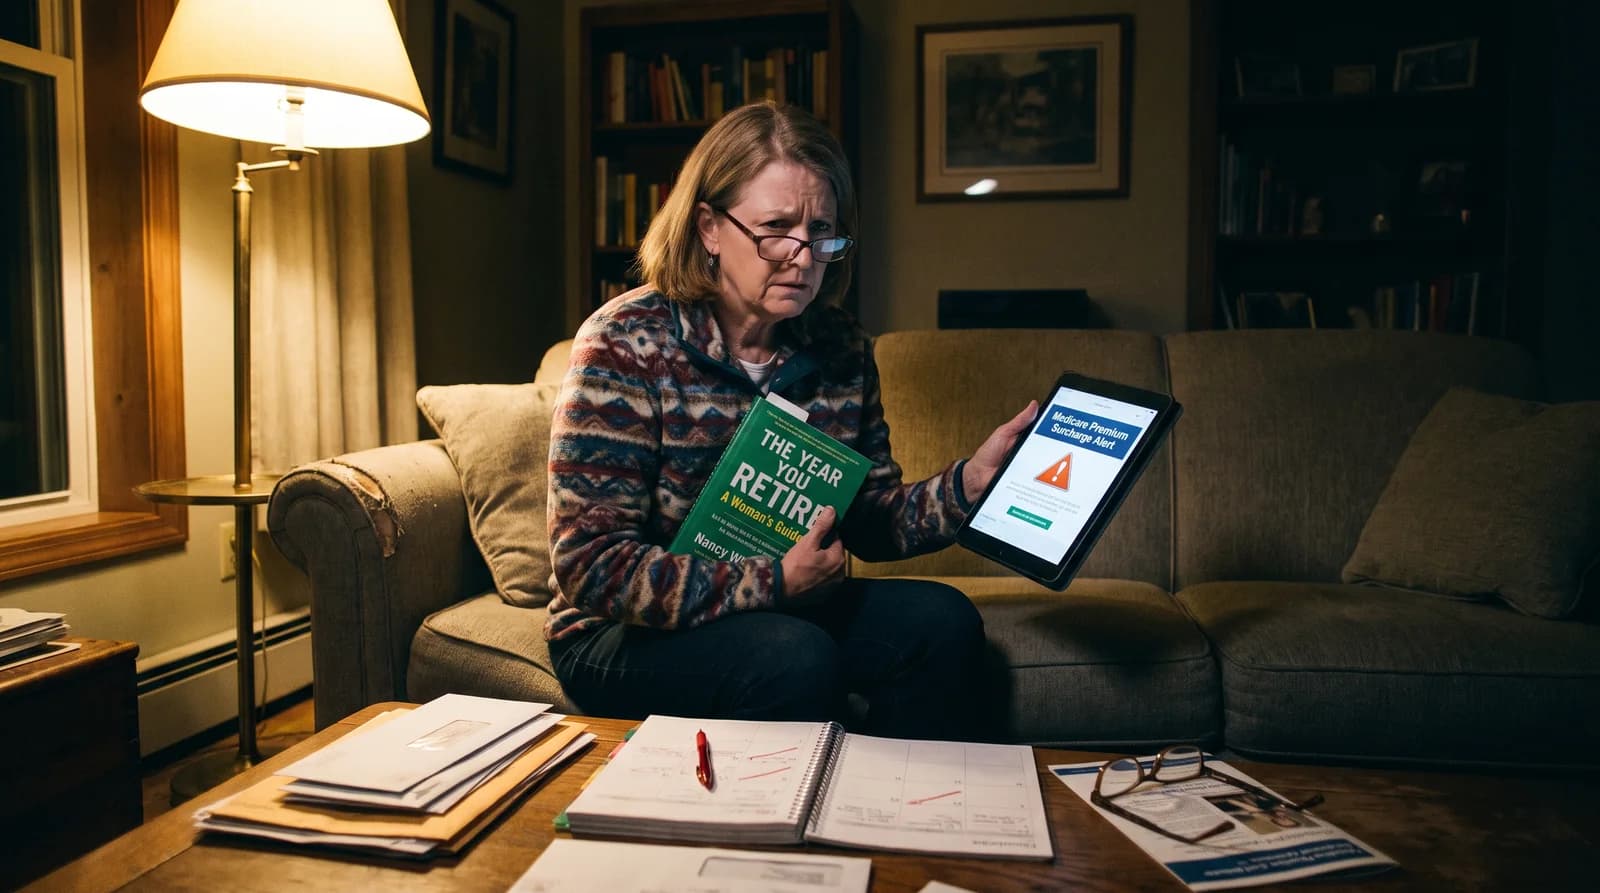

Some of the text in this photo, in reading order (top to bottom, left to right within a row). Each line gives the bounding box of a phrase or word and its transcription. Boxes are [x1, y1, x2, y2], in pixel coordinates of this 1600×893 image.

[1051, 411, 1129, 441] Medicare Premium
[1051, 423, 1116, 450] Surcharge Alert
[760, 428, 797, 460] THE
[798, 449, 843, 488] YEAR
[776, 460, 811, 490] YOU
[720, 490, 730, 503] A
[730, 495, 774, 528] Woman's
[694, 532, 728, 559] Nancy
